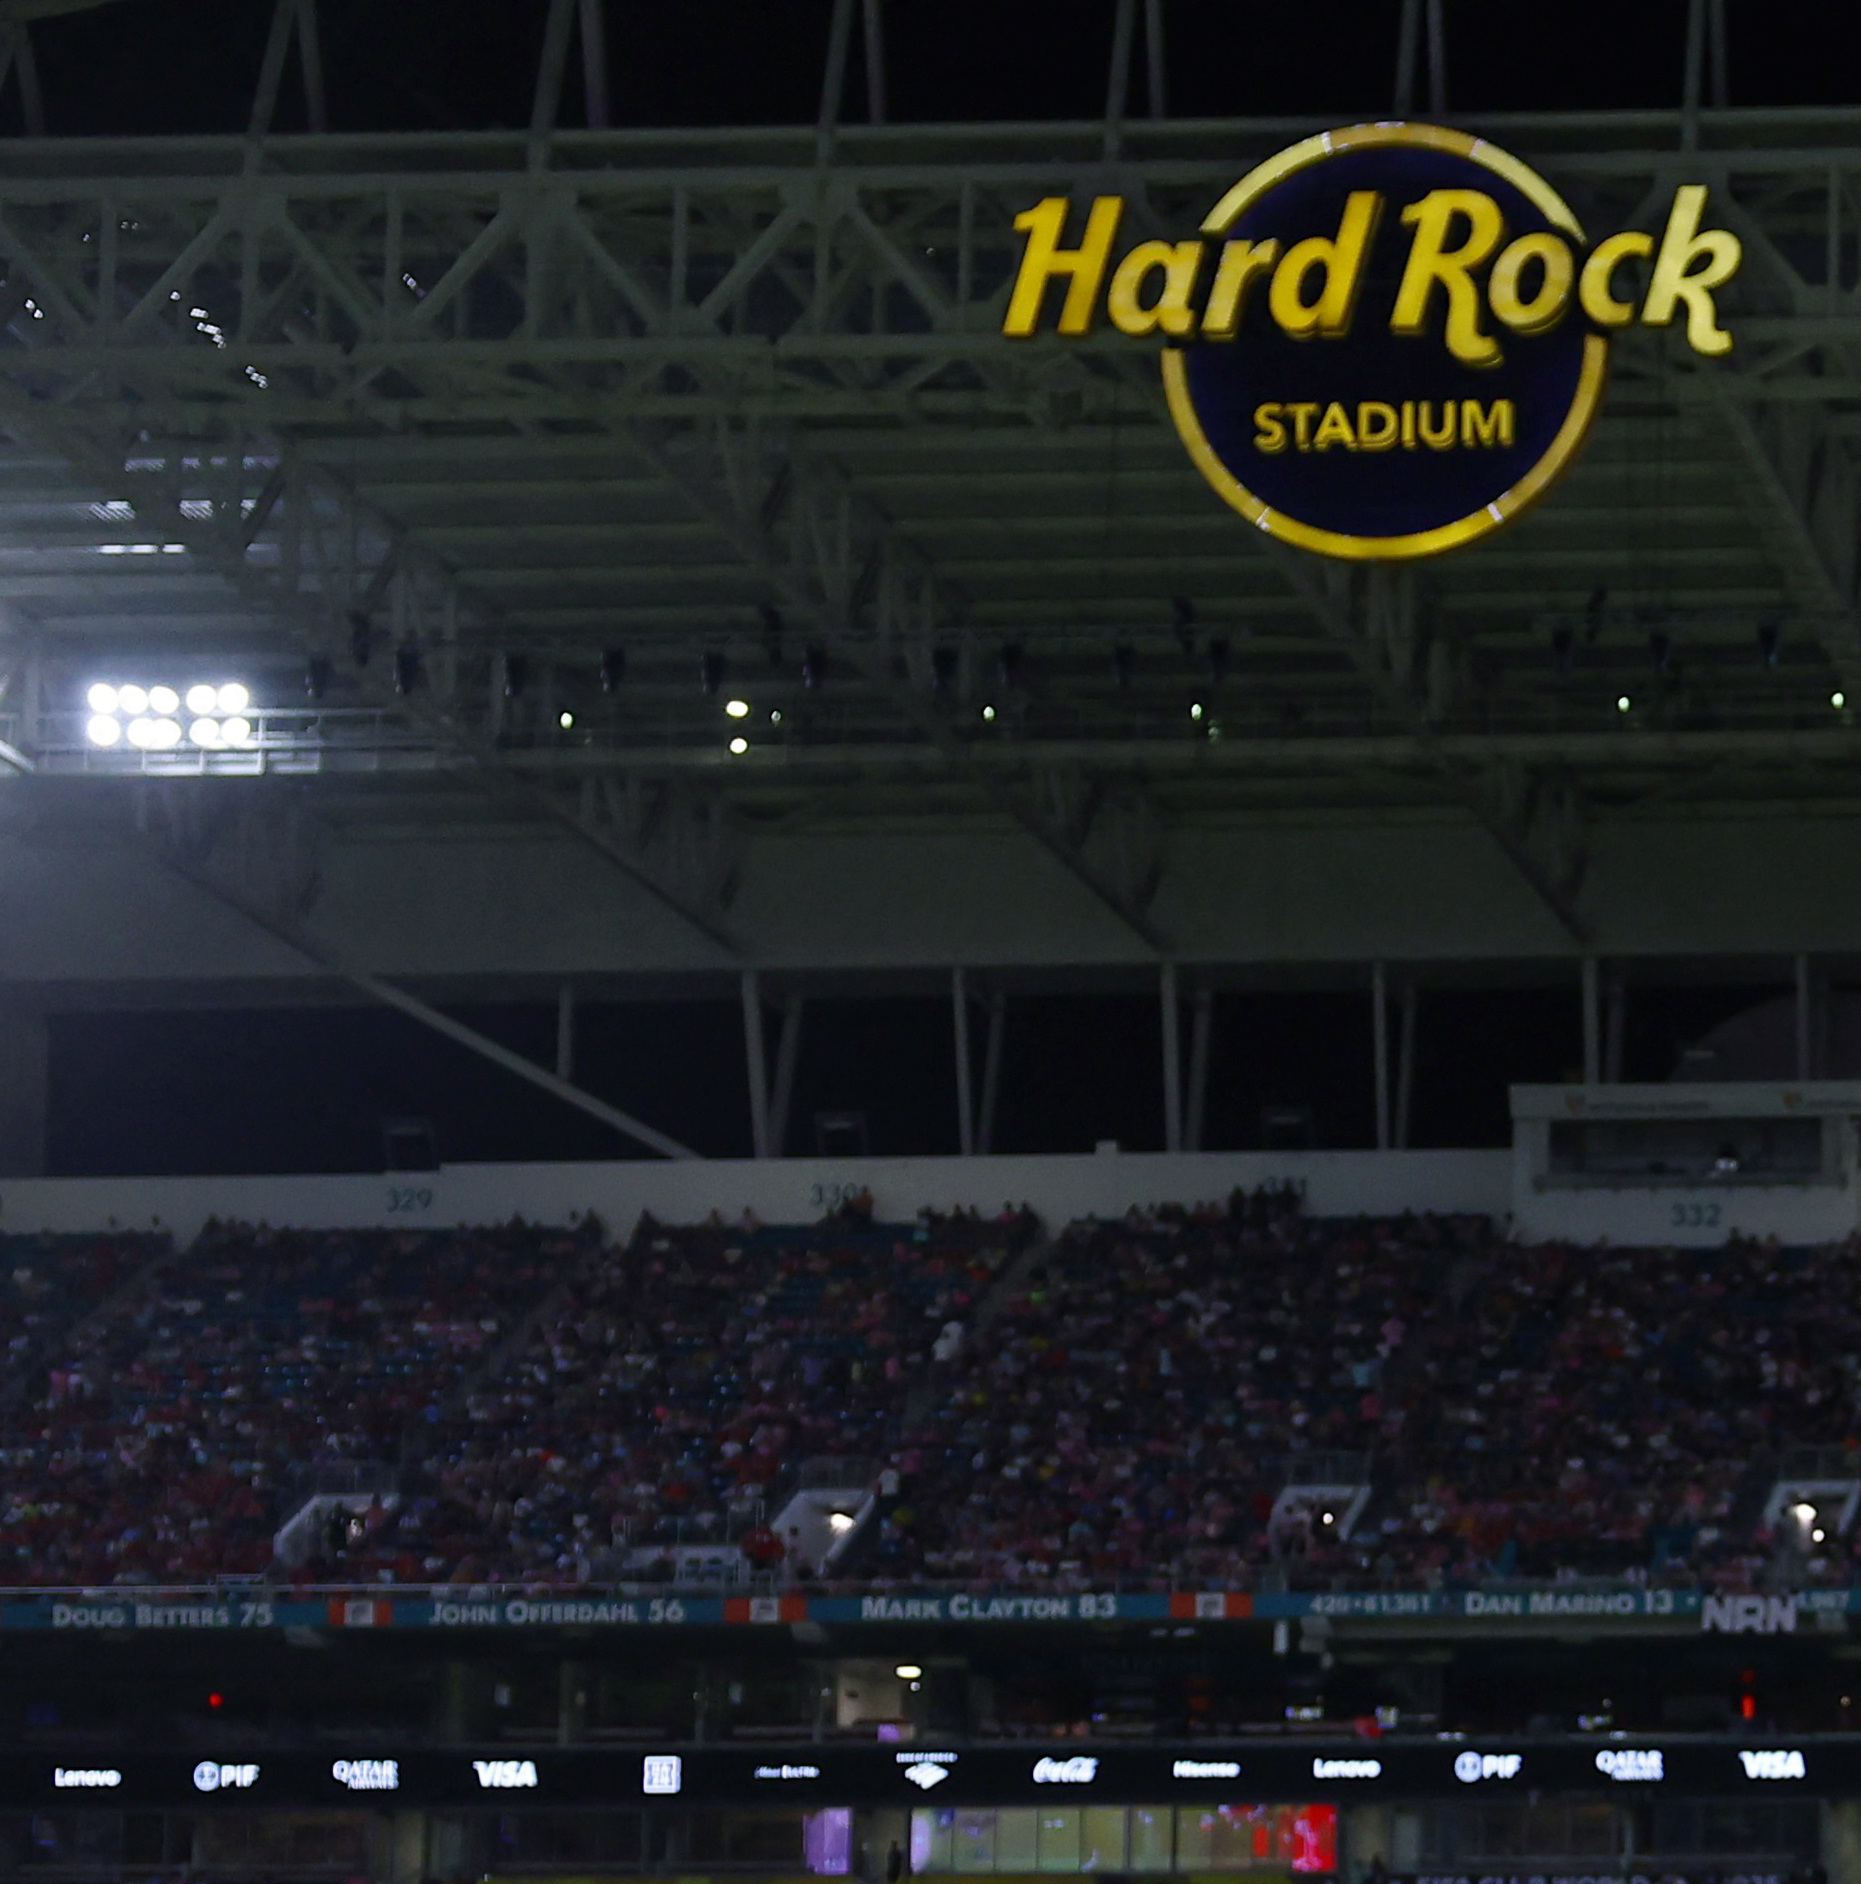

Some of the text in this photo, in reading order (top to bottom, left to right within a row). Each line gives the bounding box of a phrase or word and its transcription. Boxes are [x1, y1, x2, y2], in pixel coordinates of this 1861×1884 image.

[1003, 184, 1742, 369] Hard Rock
[1254, 399, 1513, 453] STADIUM
[648, 1599, 685, 1623] 56
[1078, 1593, 1118, 1619] 83
[55, 1768, 121, 1787] Lenovo
[221, 1764, 260, 1788] PIF
[333, 1760, 398, 1782] QATAR
[473, 1761, 538, 1787] VISA
